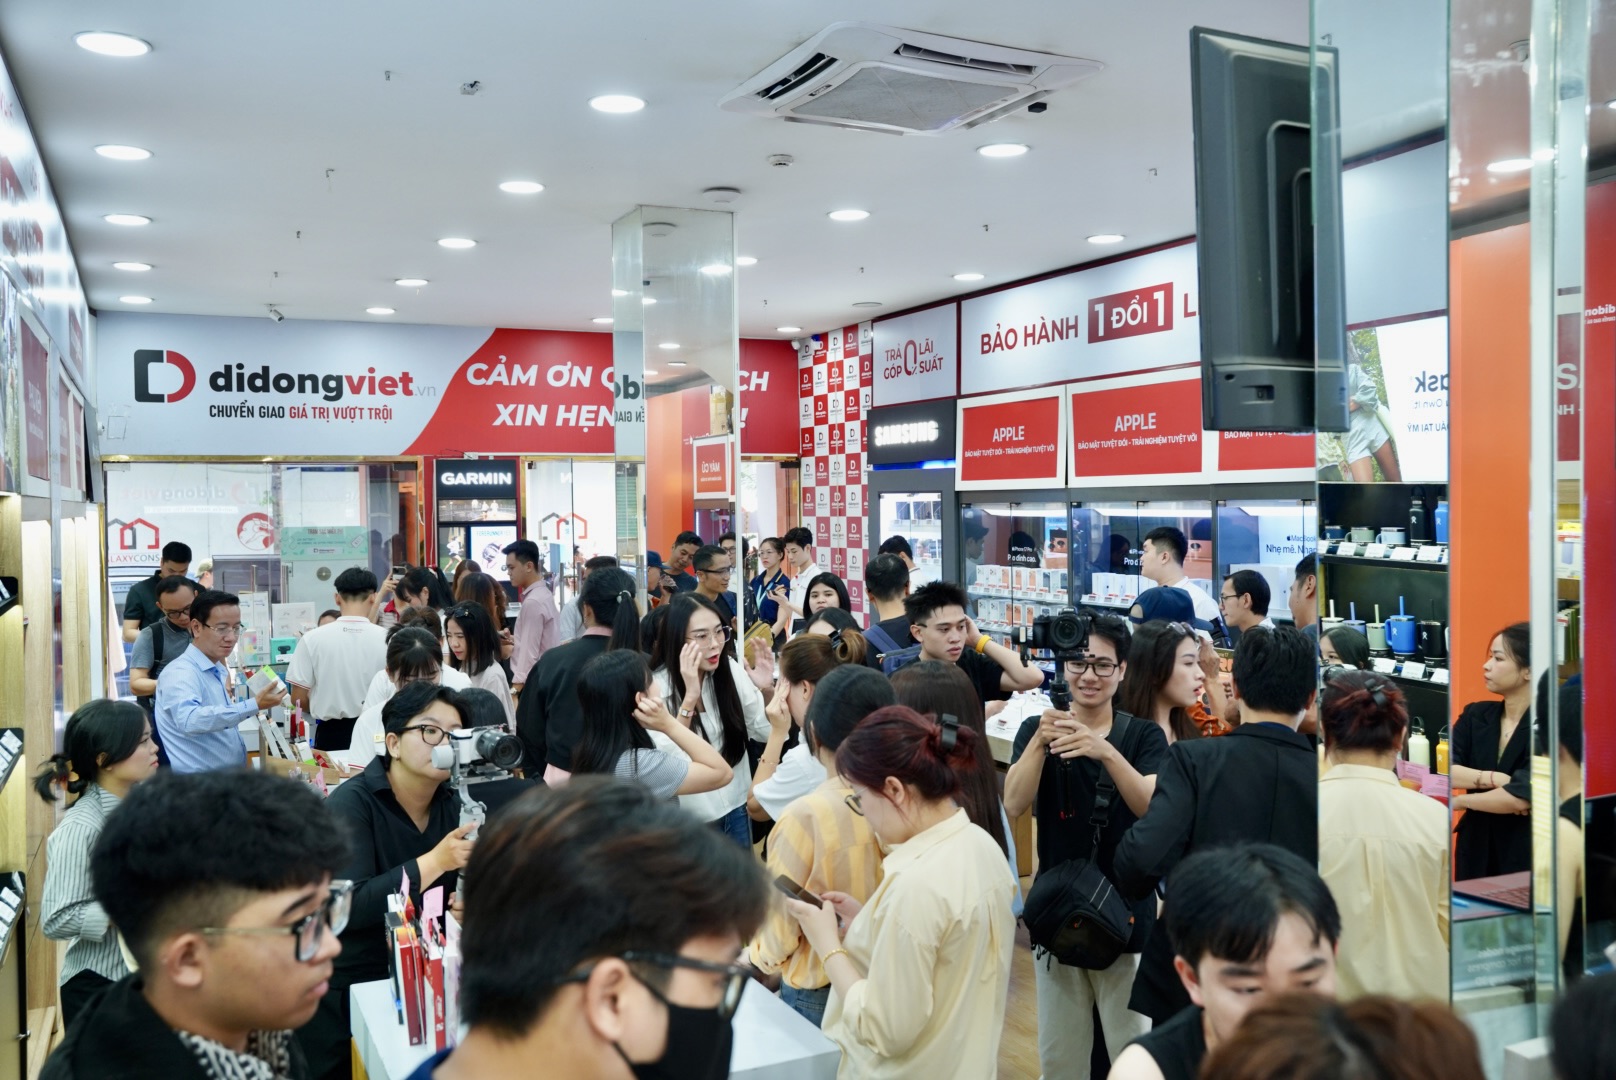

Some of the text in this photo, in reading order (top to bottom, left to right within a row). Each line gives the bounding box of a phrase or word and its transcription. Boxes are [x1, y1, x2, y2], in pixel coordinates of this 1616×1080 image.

[981, 290, 1199, 355] BẢO HÀNH 1 ĐỔI 1 L
[919, 338, 933, 355] LÃI
[466, 355, 538, 387] CẢM
[546, 362, 593, 387] ƠN
[883, 353, 943, 379] GÓP SUẤT
[209, 400, 392, 423] CHUYỂN GIAO GIÁ TRỊ VƯỢT TRỘI
[493, 404, 547, 426] XIN
[556, 405, 614, 433] HẸN
[1114, 412, 1156, 432] APPLE
[874, 420, 939, 446] SAMSUNG
[992, 426, 1024, 442] APPLE
[1168, 433, 1186, 444] TUYỆT
[441, 472, 512, 485] GARMIN
[1266, 544, 1281, 555] Nhẹ
